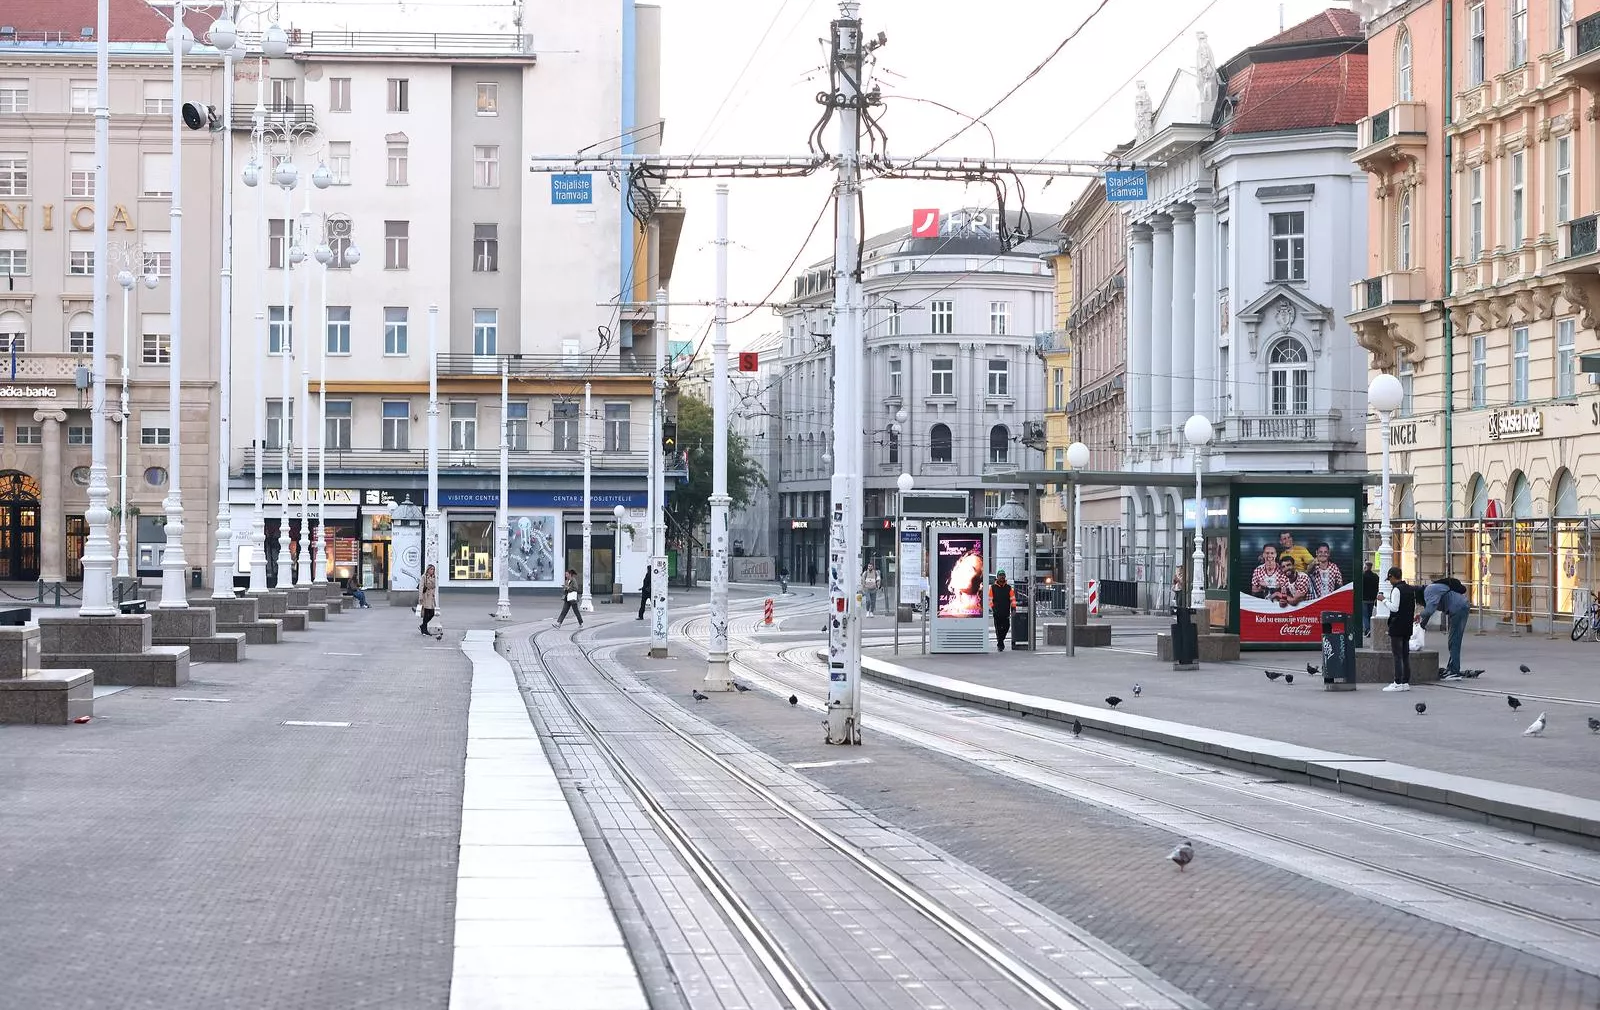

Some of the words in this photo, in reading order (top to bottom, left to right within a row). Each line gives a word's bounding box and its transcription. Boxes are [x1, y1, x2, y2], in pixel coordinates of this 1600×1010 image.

[556, 190, 588, 201] tramvaja
[1111, 187, 1144, 198] tramvaja
[743, 354, 753, 370] S
[26, 386, 57, 397] banka
[1255, 615, 1266, 623] Kad
